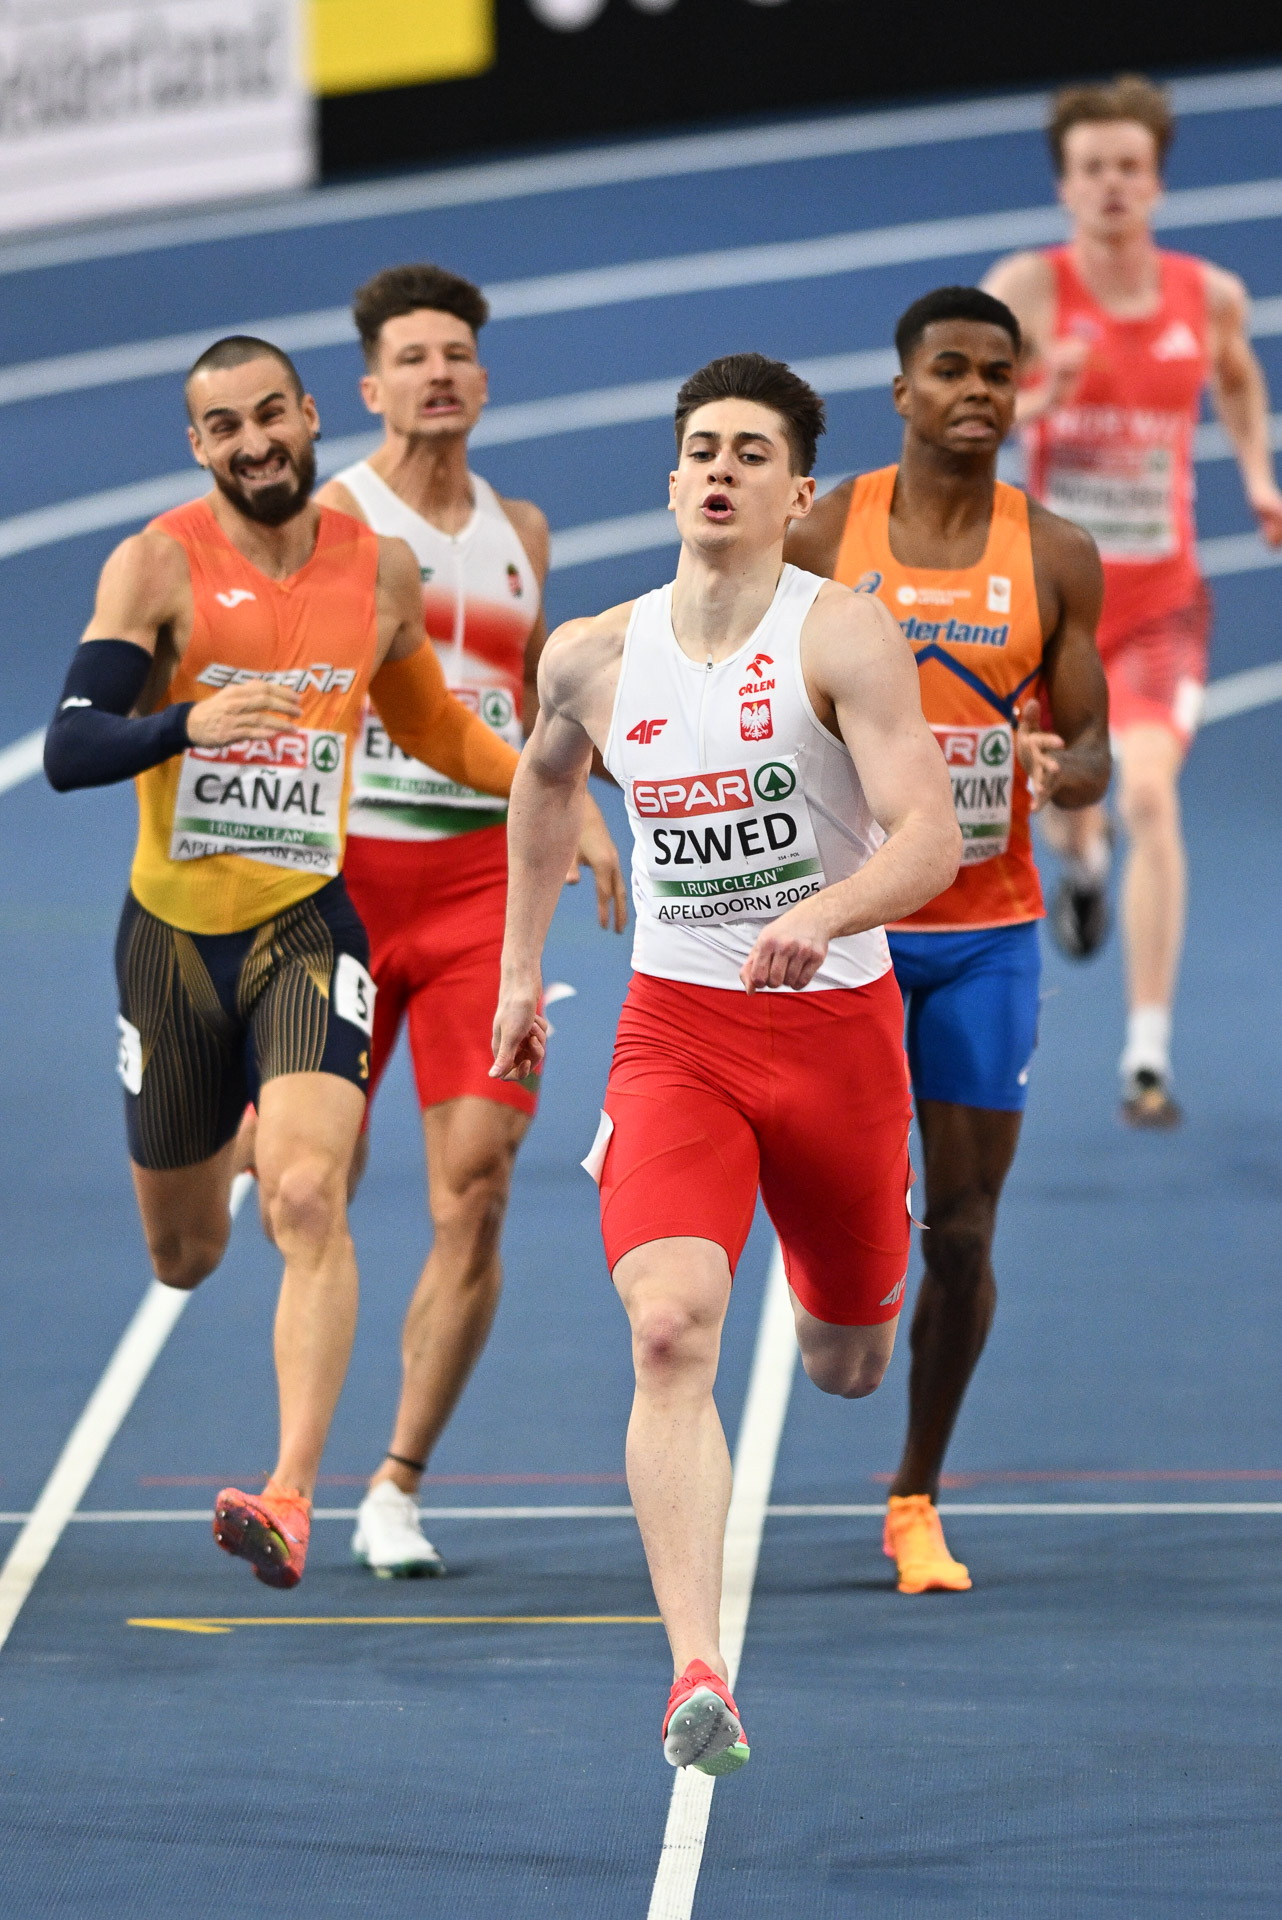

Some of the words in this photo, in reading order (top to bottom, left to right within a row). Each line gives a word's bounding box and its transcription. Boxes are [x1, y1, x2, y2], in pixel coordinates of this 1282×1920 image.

[899, 616, 1010, 648] derland
[738, 678, 776, 697] ORLEN
[626, 718, 669, 745] 4F
[194, 768, 326, 816] CAÑAL
[634, 775, 750, 814] SPAR
[952, 775, 1009, 809] KINK
[216, 823, 250, 837] RUN
[253, 827, 306, 843] CLEAN
[652, 812, 798, 866] SZWED
[658, 894, 772, 920] APELDOORN
[775, 881, 820, 907] 2025
[681, 882, 687, 896] I
[689, 880, 720, 895] RUN
